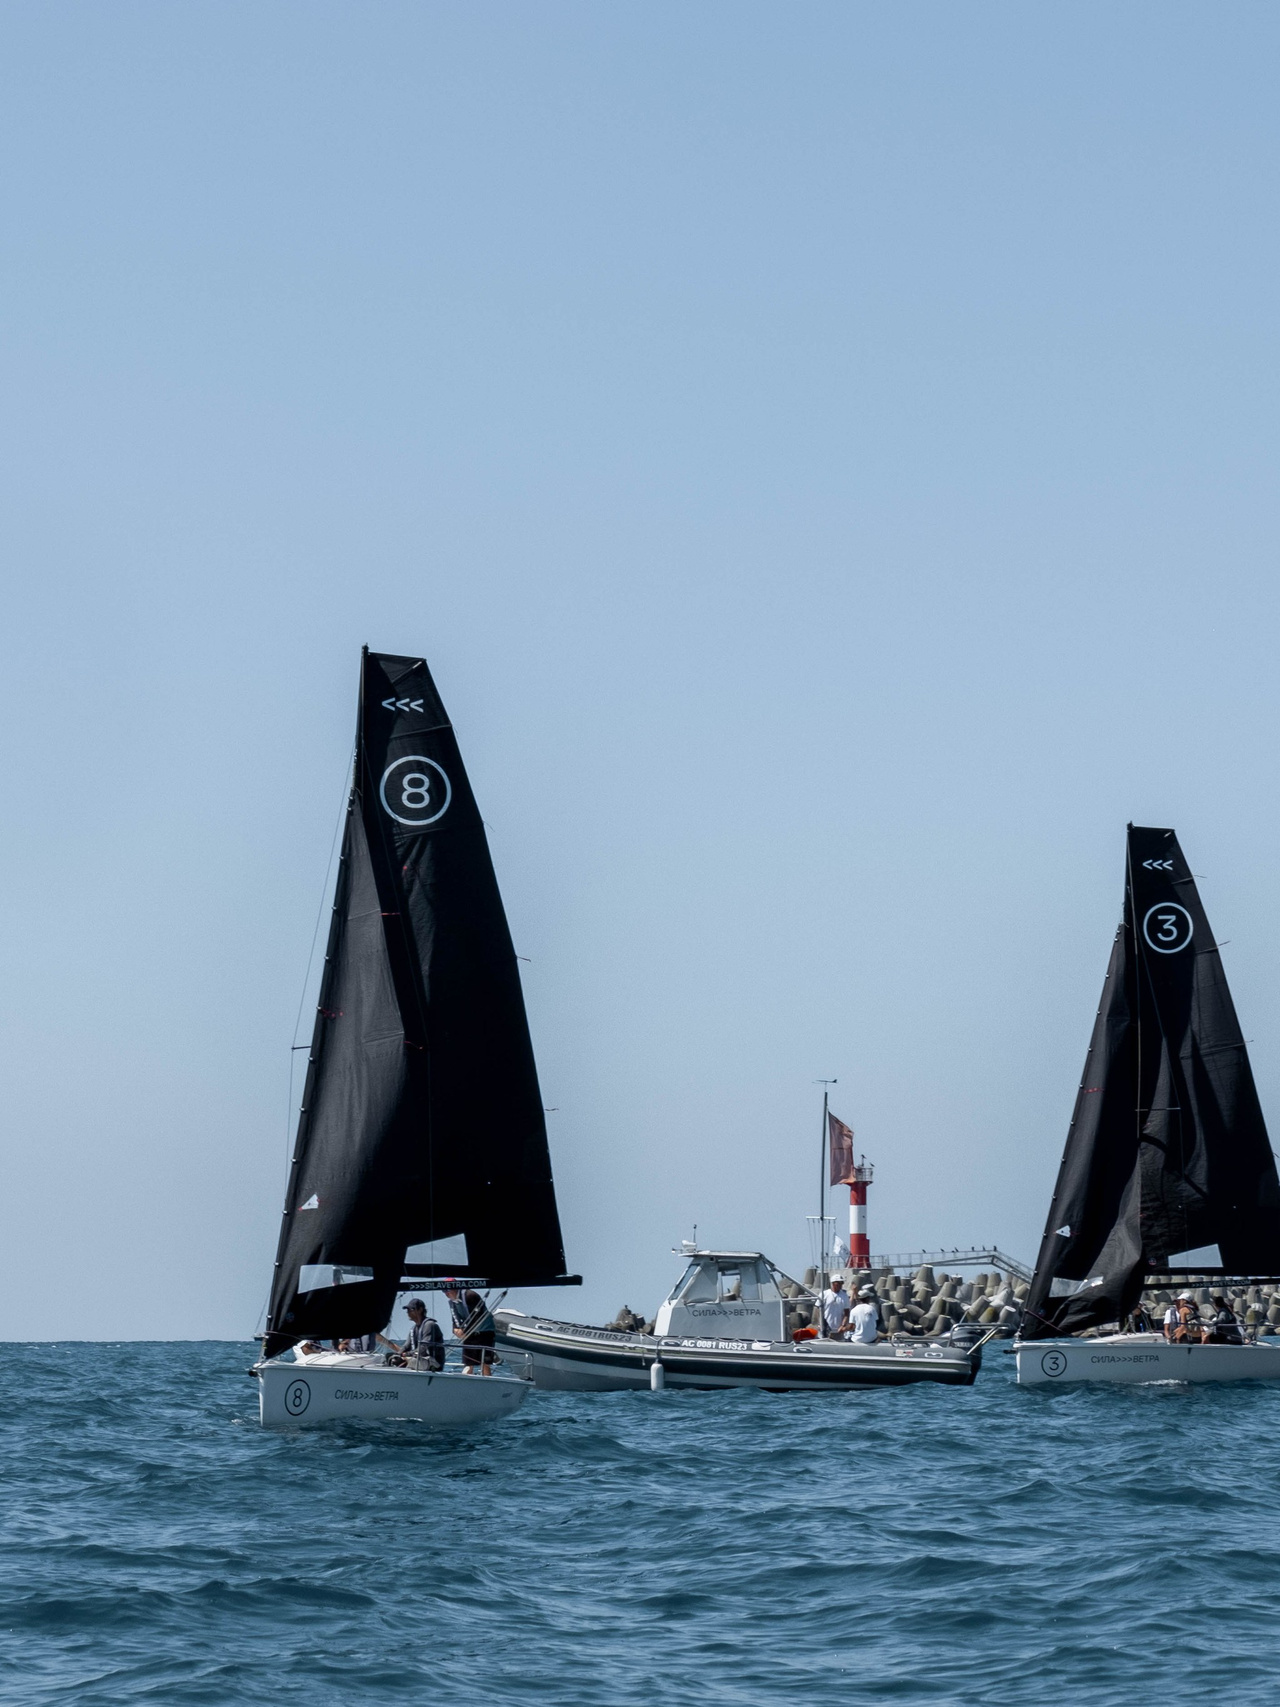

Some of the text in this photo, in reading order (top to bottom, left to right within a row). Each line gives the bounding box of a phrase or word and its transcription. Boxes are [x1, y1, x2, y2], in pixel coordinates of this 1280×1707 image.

[401, 773, 430, 808] 8
[1157, 915, 1178, 941] 3
[697, 1340, 717, 1349] 0081
[718, 1341, 748, 1351] RUS23
[1048, 1356, 1060, 1371] 3
[292, 1387, 303, 1408] 8
